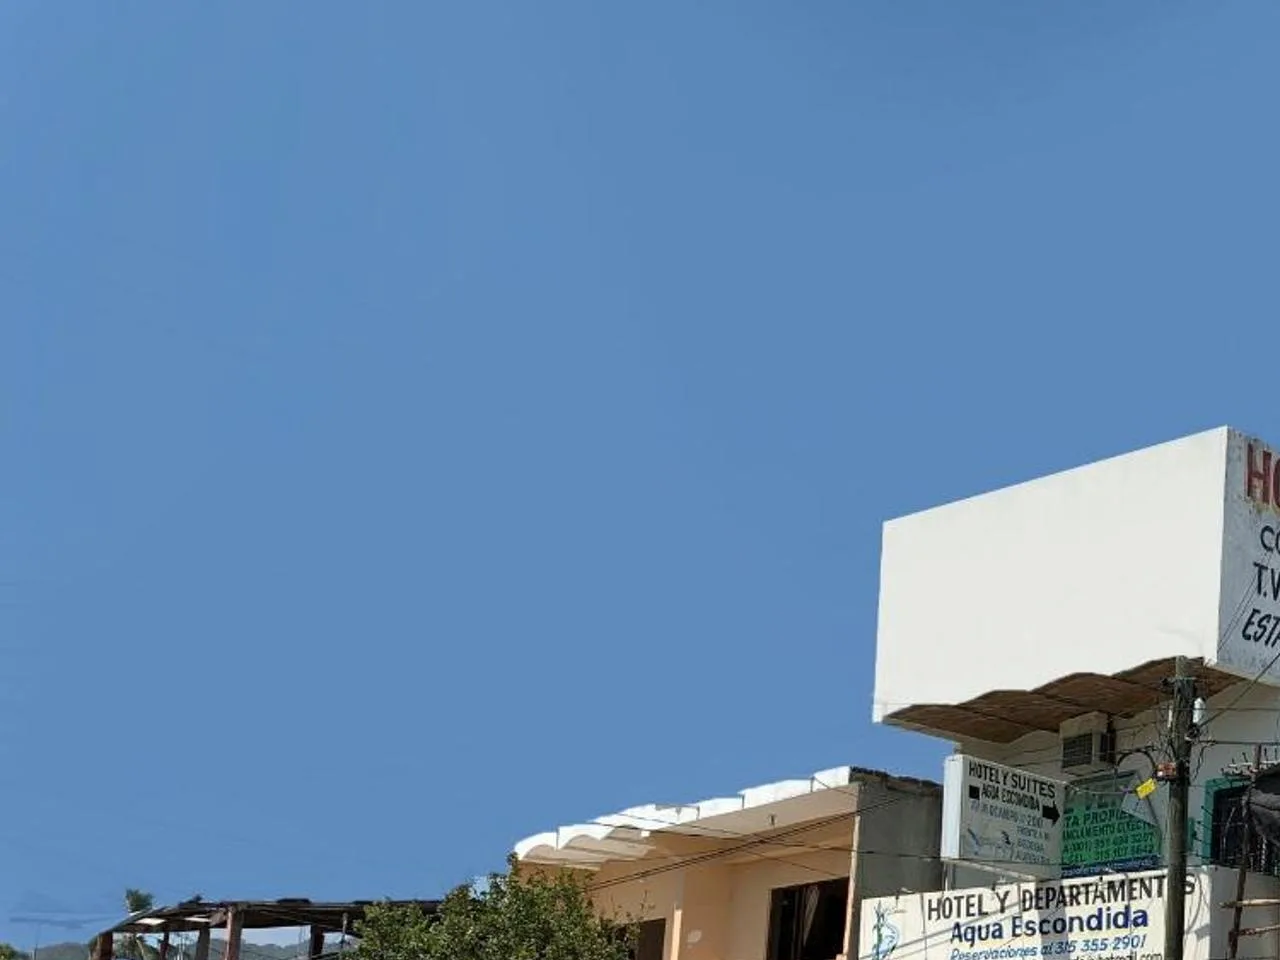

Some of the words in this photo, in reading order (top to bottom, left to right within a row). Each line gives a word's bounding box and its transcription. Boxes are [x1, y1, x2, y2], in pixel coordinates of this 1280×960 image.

[968, 759, 1001, 785] HOTEL
[1001, 771, 1010, 787] Y
[1010, 772, 1056, 799] SUITES
[927, 893, 989, 921] HOTEL
[995, 889, 1010, 914] Y
[1022, 872, 1196, 913] DEPARTAMENTS
[949, 920, 1004, 949] Agua
[1011, 904, 1149, 939] Escondida
